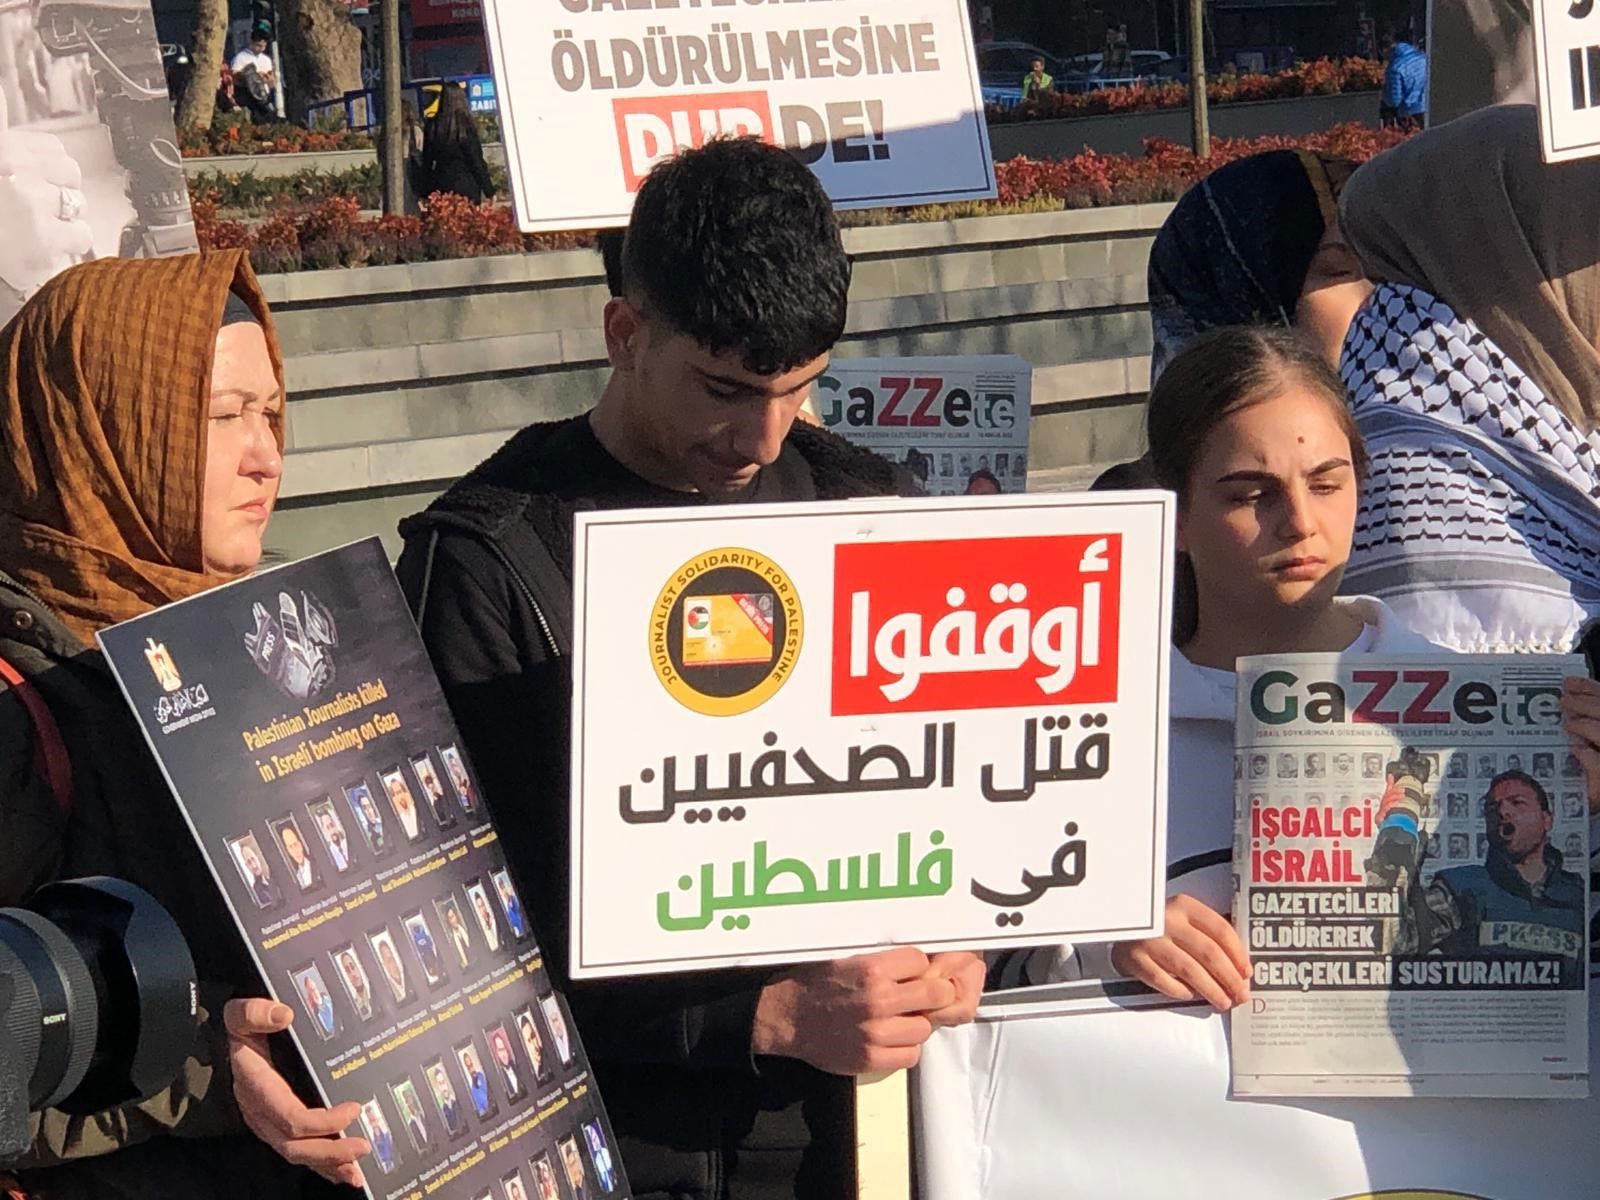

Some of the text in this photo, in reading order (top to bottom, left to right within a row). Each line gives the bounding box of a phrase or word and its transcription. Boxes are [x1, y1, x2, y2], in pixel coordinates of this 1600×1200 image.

[551, 16, 941, 92] ÖLDÜRÜLMESİNE
[779, 99, 890, 165] DE!
[677, 553, 763, 586] SOLIDARITY
[764, 567, 788, 594] FOR
[655, 586, 677, 685] JOURNALIST
[772, 597, 799, 682] PALESTINE
[849, 538, 1109, 702] أوقفوا
[242, 714, 306, 751] Palestinian
[303, 691, 361, 727] Journalists
[357, 678, 388, 706] killed
[255, 711, 401, 783] in Israeli bombing on Gaza
[618, 712, 1110, 825] قتل الصحفيين
[1252, 799, 1372, 846] İŞGALCİ
[657, 821, 1086, 931] في فلسطين
[1252, 840, 1362, 882] İSRAİL
[1251, 887, 1400, 915] GAZETECİLERİ
[1251, 920, 1375, 949] ÖLDÜREREK
[189, 981, 197, 1016] SONY
[1254, 956, 1560, 990] GERÇEKLERİ SUSTURAMAZ!
[43, 1013, 67, 1025] SONY
